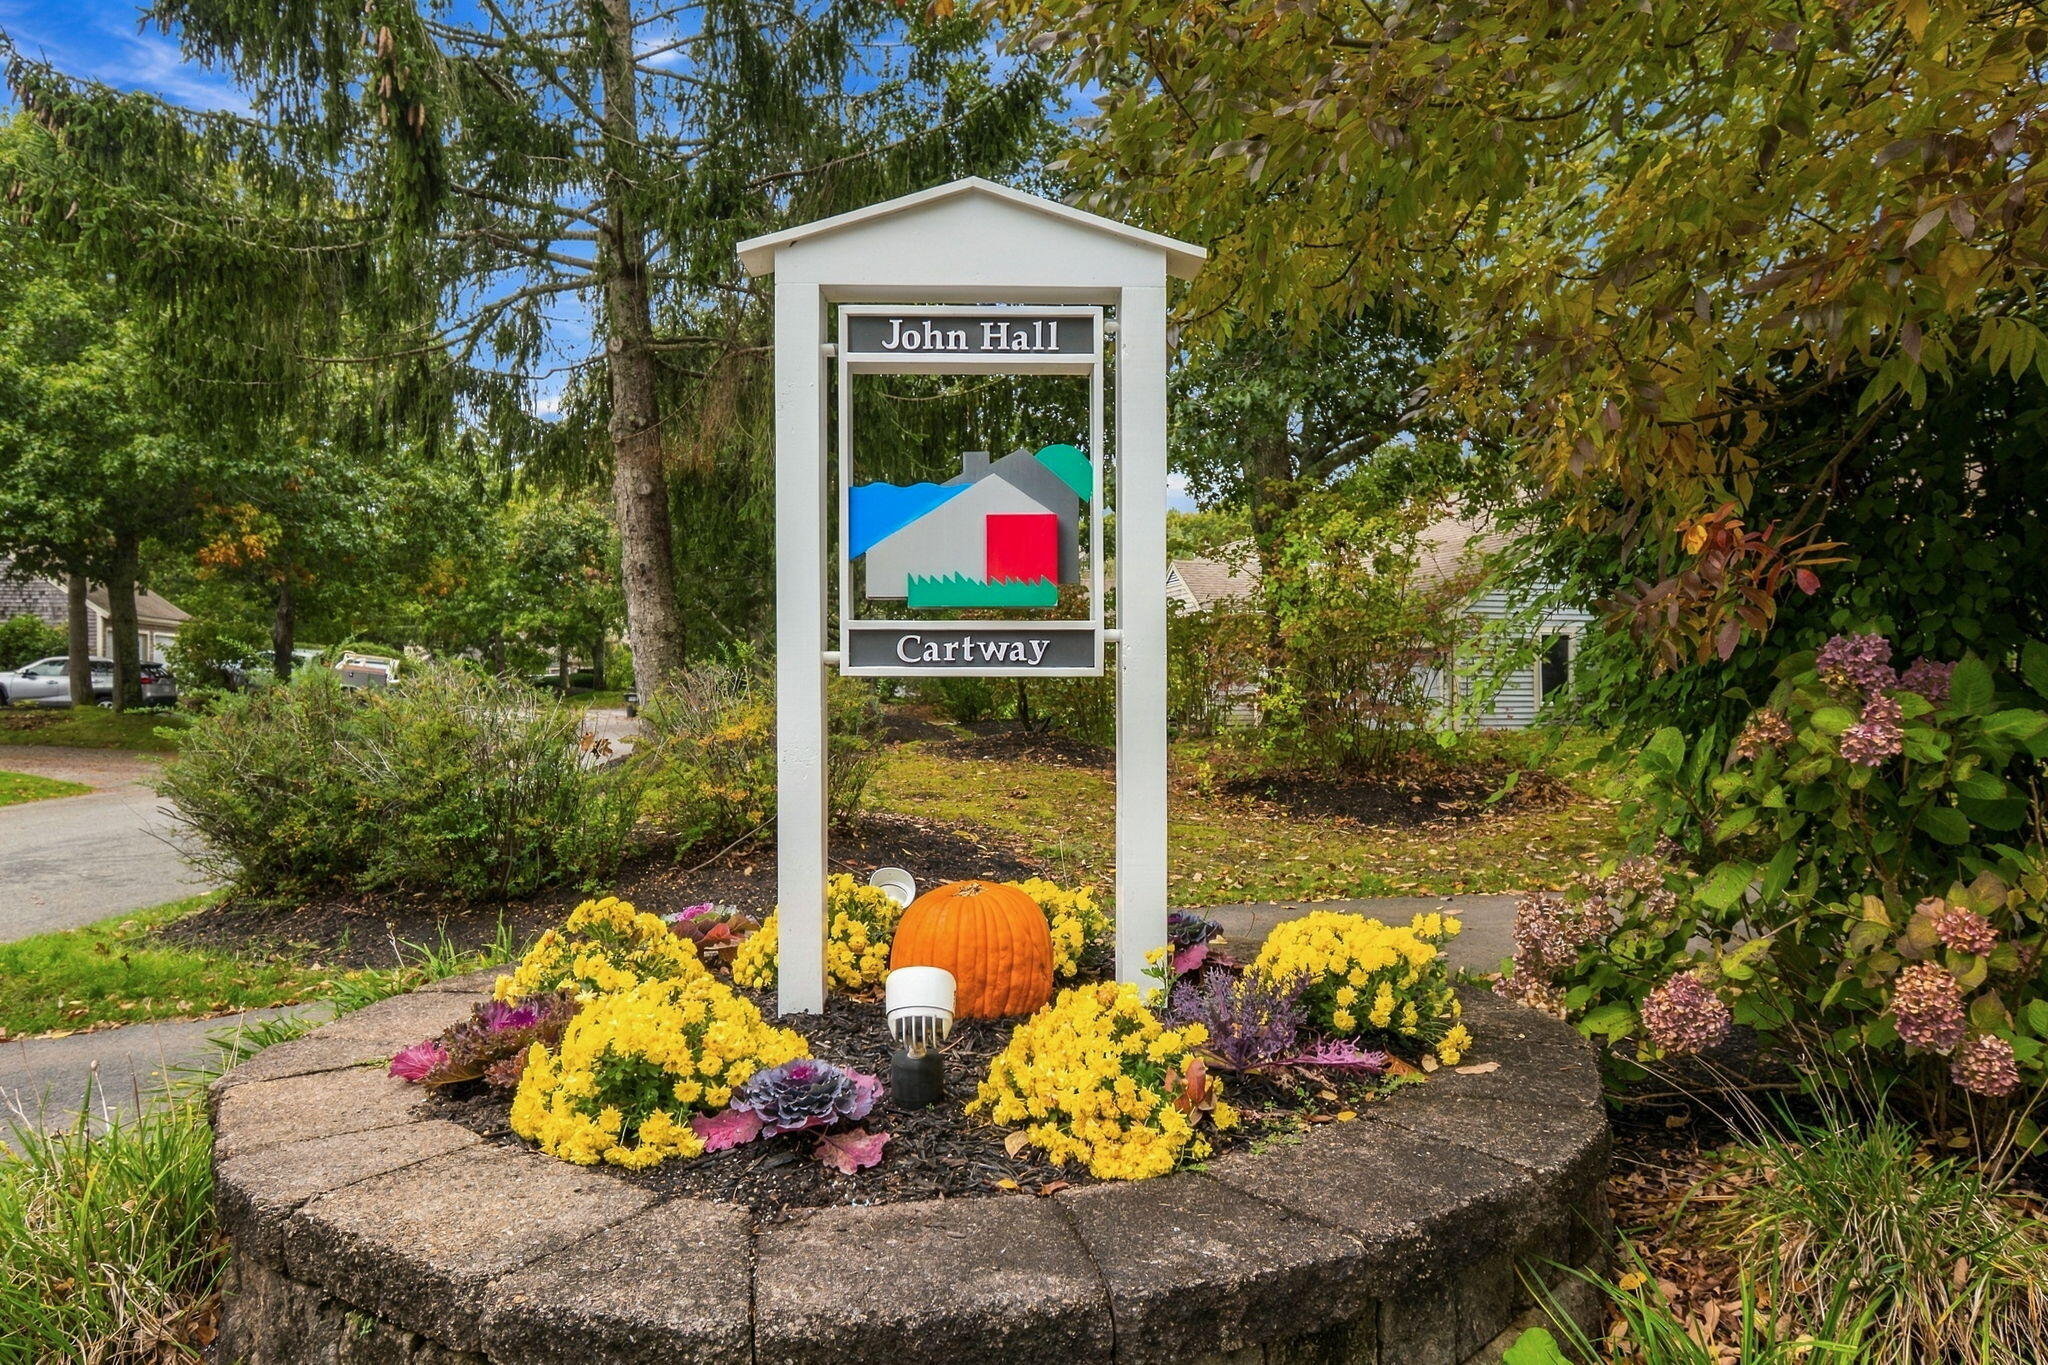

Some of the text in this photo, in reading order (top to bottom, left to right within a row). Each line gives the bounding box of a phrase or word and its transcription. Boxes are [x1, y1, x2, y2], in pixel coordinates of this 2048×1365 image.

[881, 319, 1060, 351] John Hall
[896, 634, 1051, 666] Cartway
